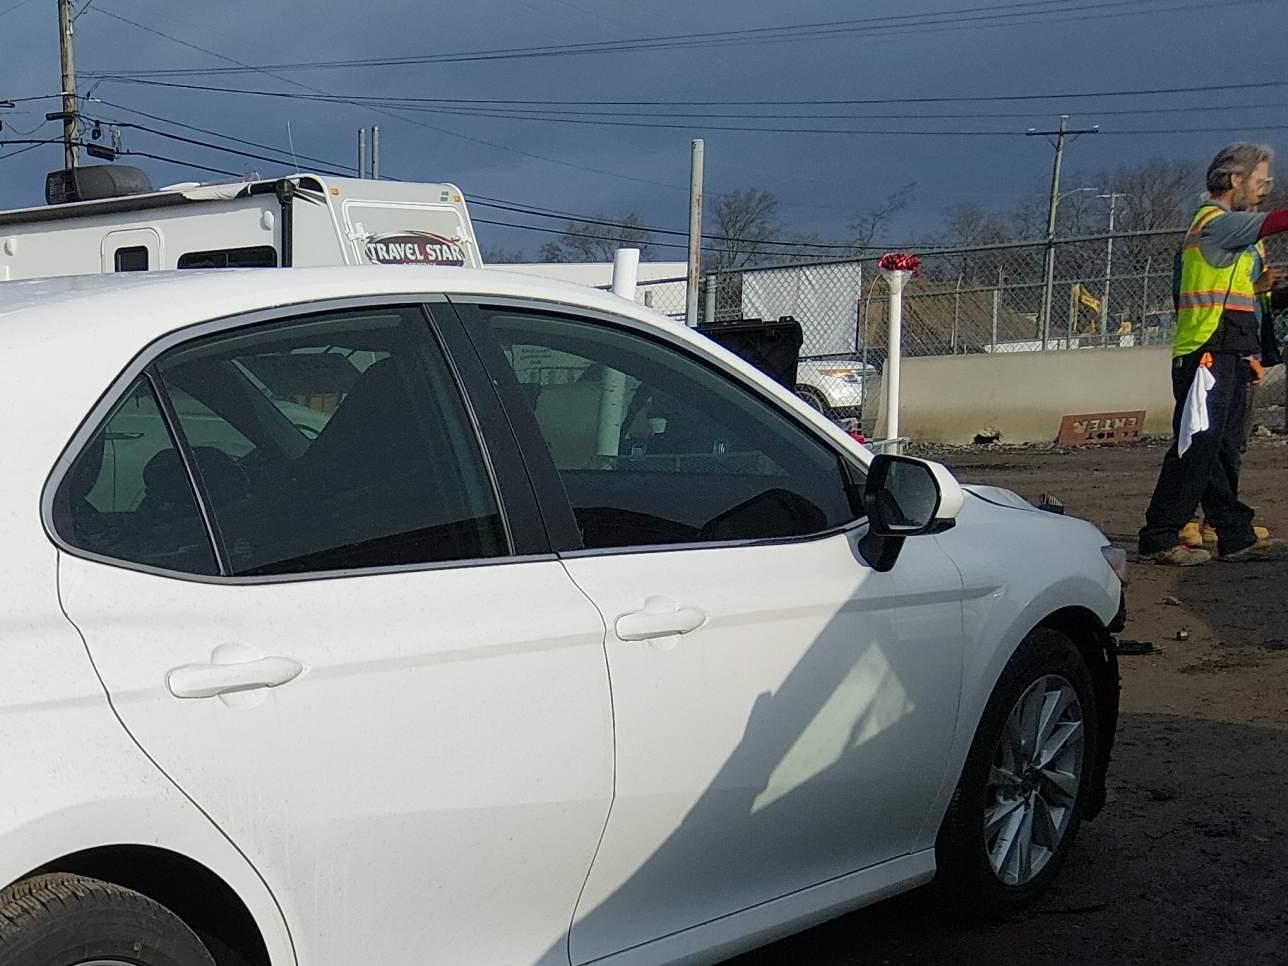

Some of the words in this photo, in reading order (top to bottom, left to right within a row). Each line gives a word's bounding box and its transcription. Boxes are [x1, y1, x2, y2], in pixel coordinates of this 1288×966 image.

[366, 243, 424, 261] TRAVEL
[425, 244, 463, 261] STAR
[1073, 417, 1137, 434] ENTER
[1085, 431, 1115, 440] NOT
